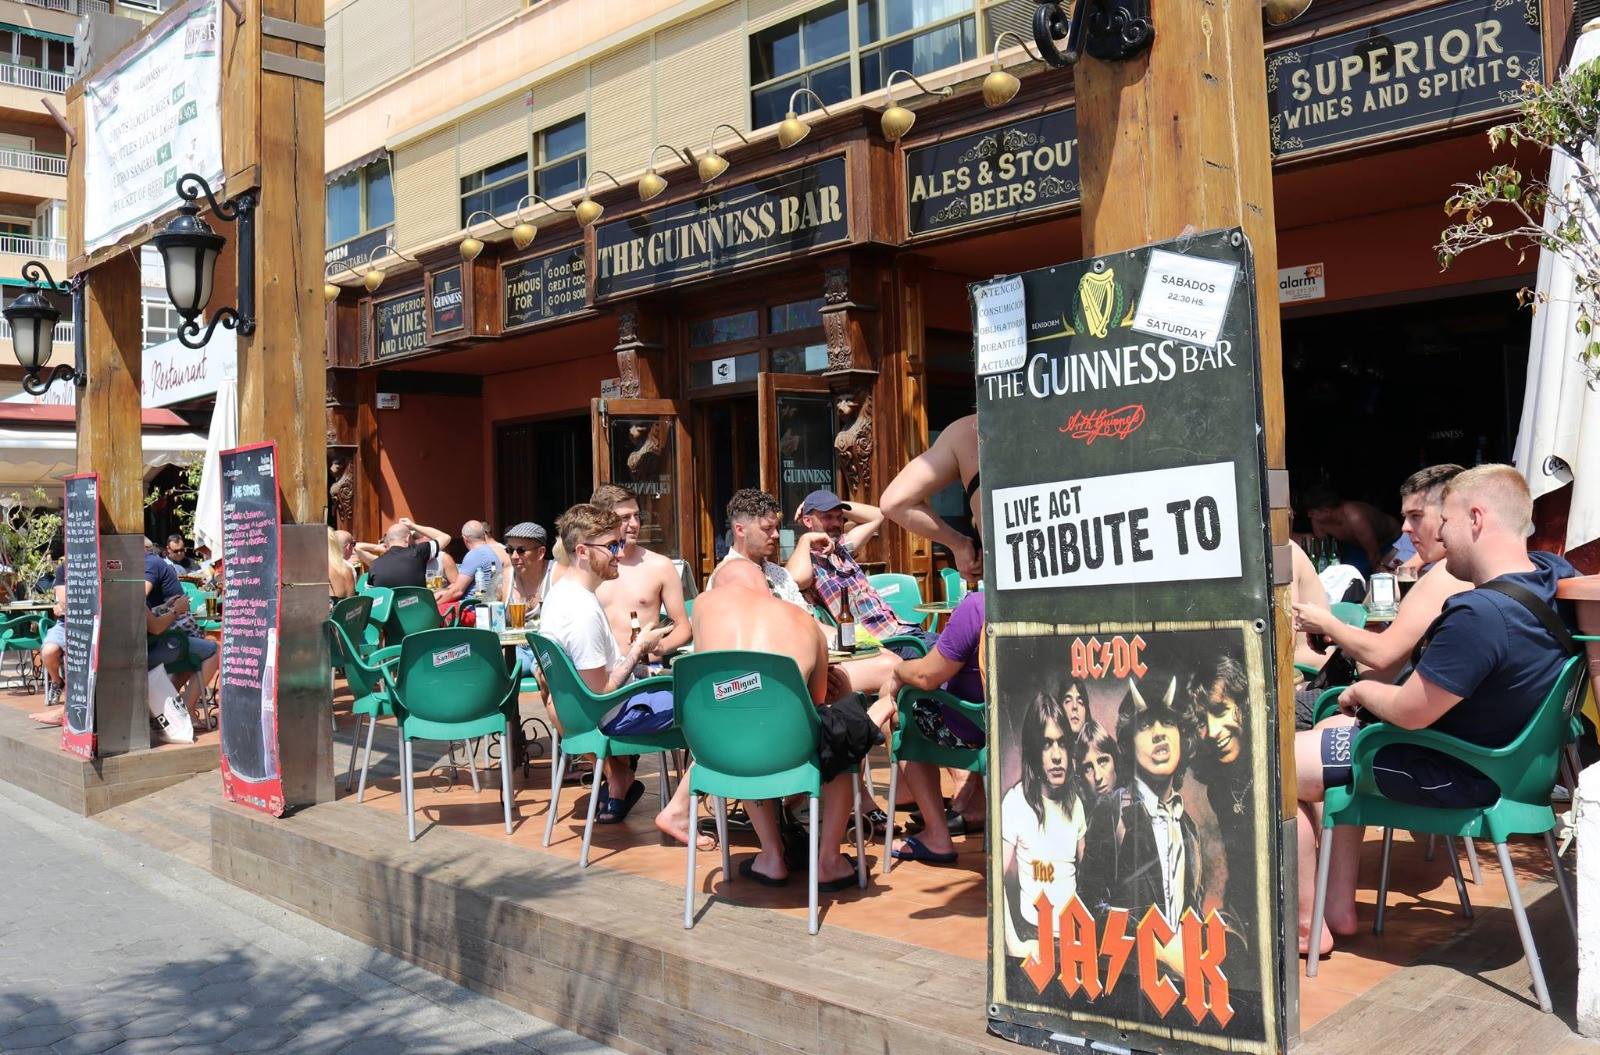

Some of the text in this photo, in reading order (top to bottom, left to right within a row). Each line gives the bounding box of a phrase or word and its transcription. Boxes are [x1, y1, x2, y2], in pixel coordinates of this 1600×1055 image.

[1291, 19, 1504, 102] SUPERIOR
[1283, 55, 1521, 131] WINES AND SPIRITS
[911, 165, 973, 203] ALES
[977, 160, 994, 186] &
[969, 179, 1037, 216] BEERS
[597, 184, 843, 279] THE GUINNESS BAR
[547, 263, 571, 279] GOOD
[507, 277, 541, 298] FAMOUS
[547, 277, 571, 293] GREAT
[1161, 274, 1216, 294] SABADOS
[1280, 275, 1316, 290] alarm
[392, 297, 426, 315] SUPERIOR
[515, 294, 533, 311] FOR
[547, 291, 572, 306] GOOD
[1031, 319, 1060, 331] BENIDORM
[1145, 318, 1207, 340] SATURDAY
[380, 339, 396, 355] AND
[980, 337, 1016, 353] DURANTE
[152, 347, 208, 399] Restaurant
[984, 339, 1237, 400] THE GUINNESS BAR
[783, 469, 832, 483] GUINNESS
[1004, 485, 1082, 528] LIVE ACT
[1006, 495, 1222, 583] TRIBUTE TO
[1031, 860, 1055, 883] The
